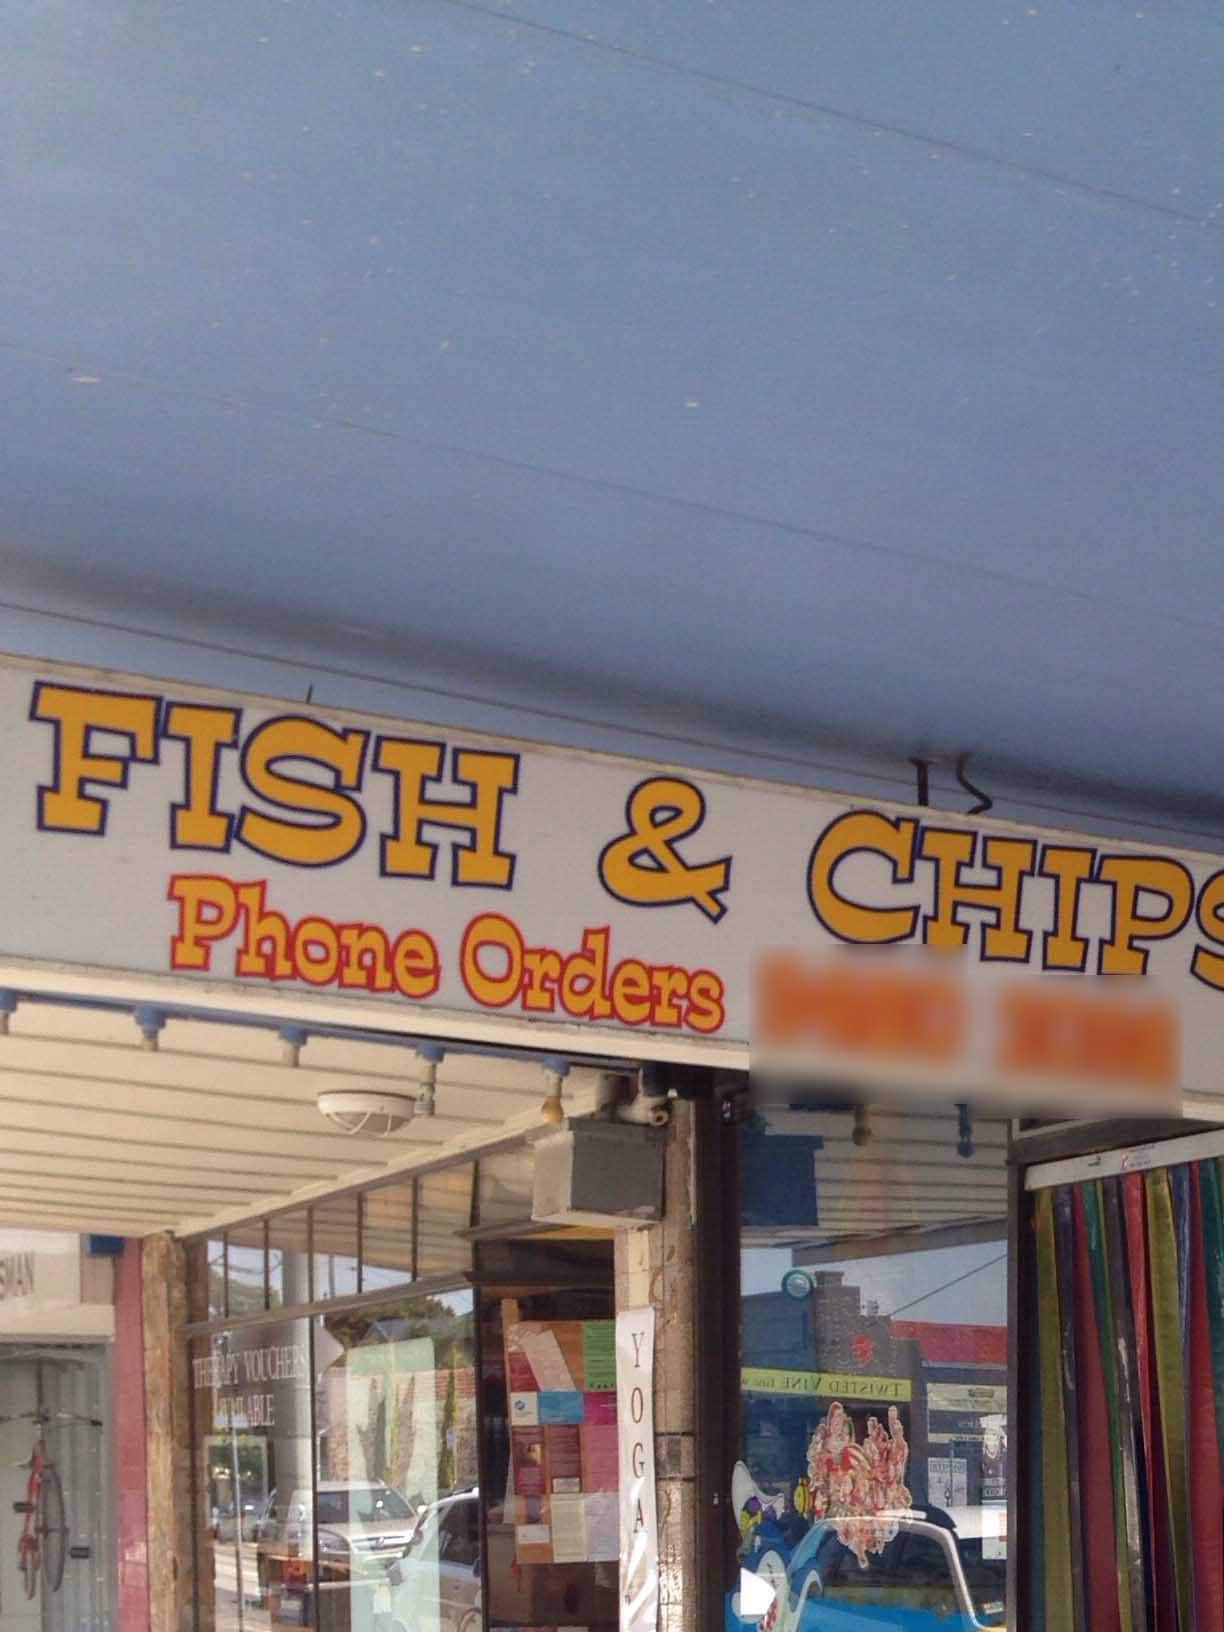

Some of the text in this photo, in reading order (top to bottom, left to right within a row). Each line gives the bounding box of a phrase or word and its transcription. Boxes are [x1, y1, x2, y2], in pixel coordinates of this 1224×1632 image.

[28, 680, 520, 890] FISH
[599, 776, 732, 924] &
[167, 873, 440, 998] Phone
[459, 911, 726, 1034] Orders
